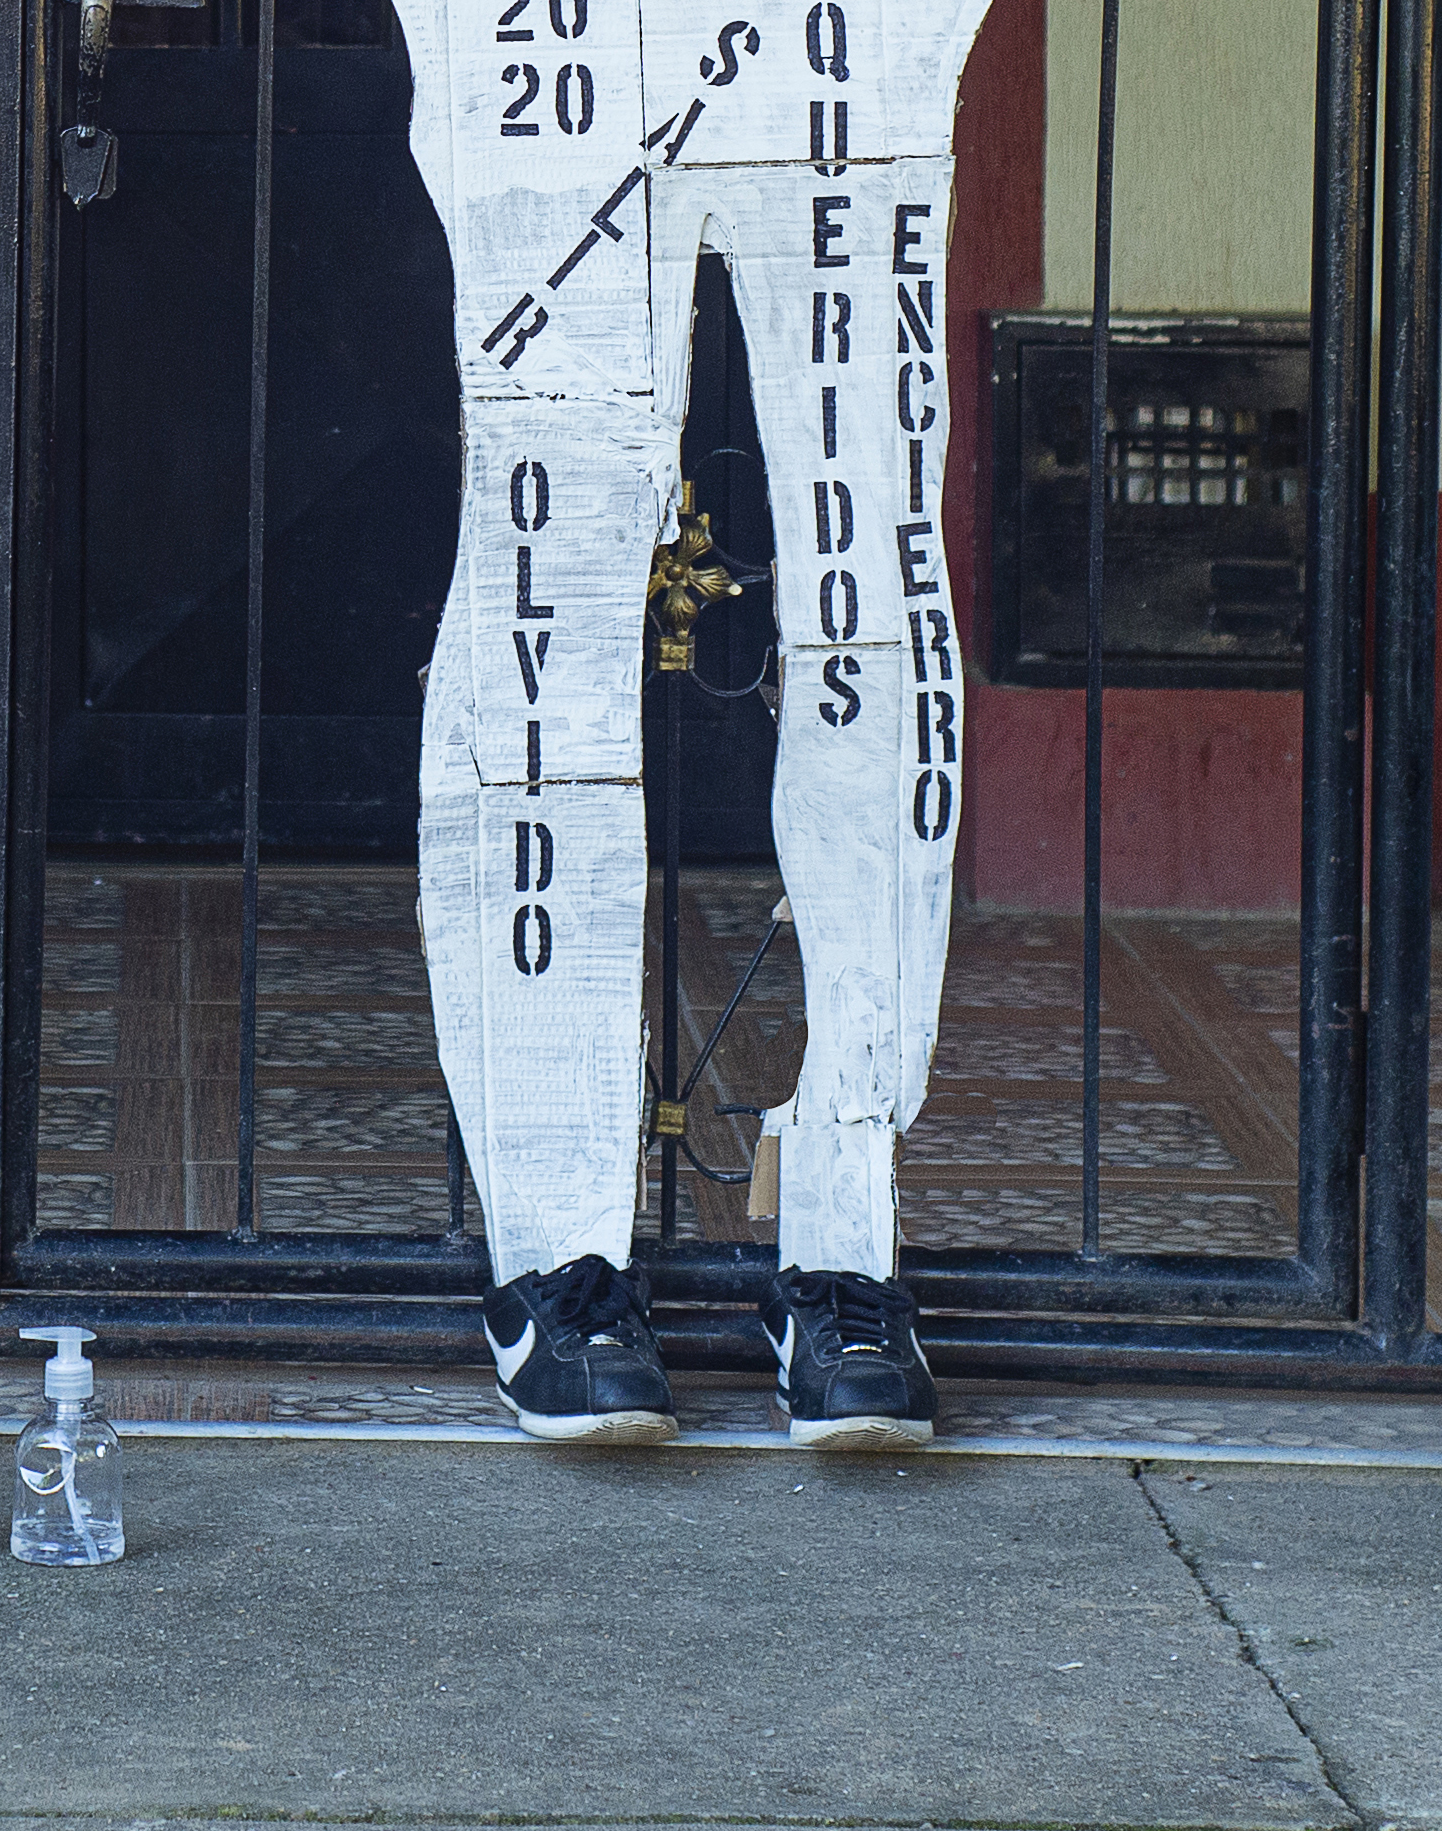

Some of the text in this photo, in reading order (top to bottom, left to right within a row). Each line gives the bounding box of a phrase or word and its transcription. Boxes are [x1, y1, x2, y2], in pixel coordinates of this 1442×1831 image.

[480, 20, 761, 371] SALIR
[500, 62, 595, 137] 20
[805, 1, 862, 728] QUERIDOS
[891, 203, 959, 844] ENCIERRO
[509, 455, 555, 977] OLVIDO
